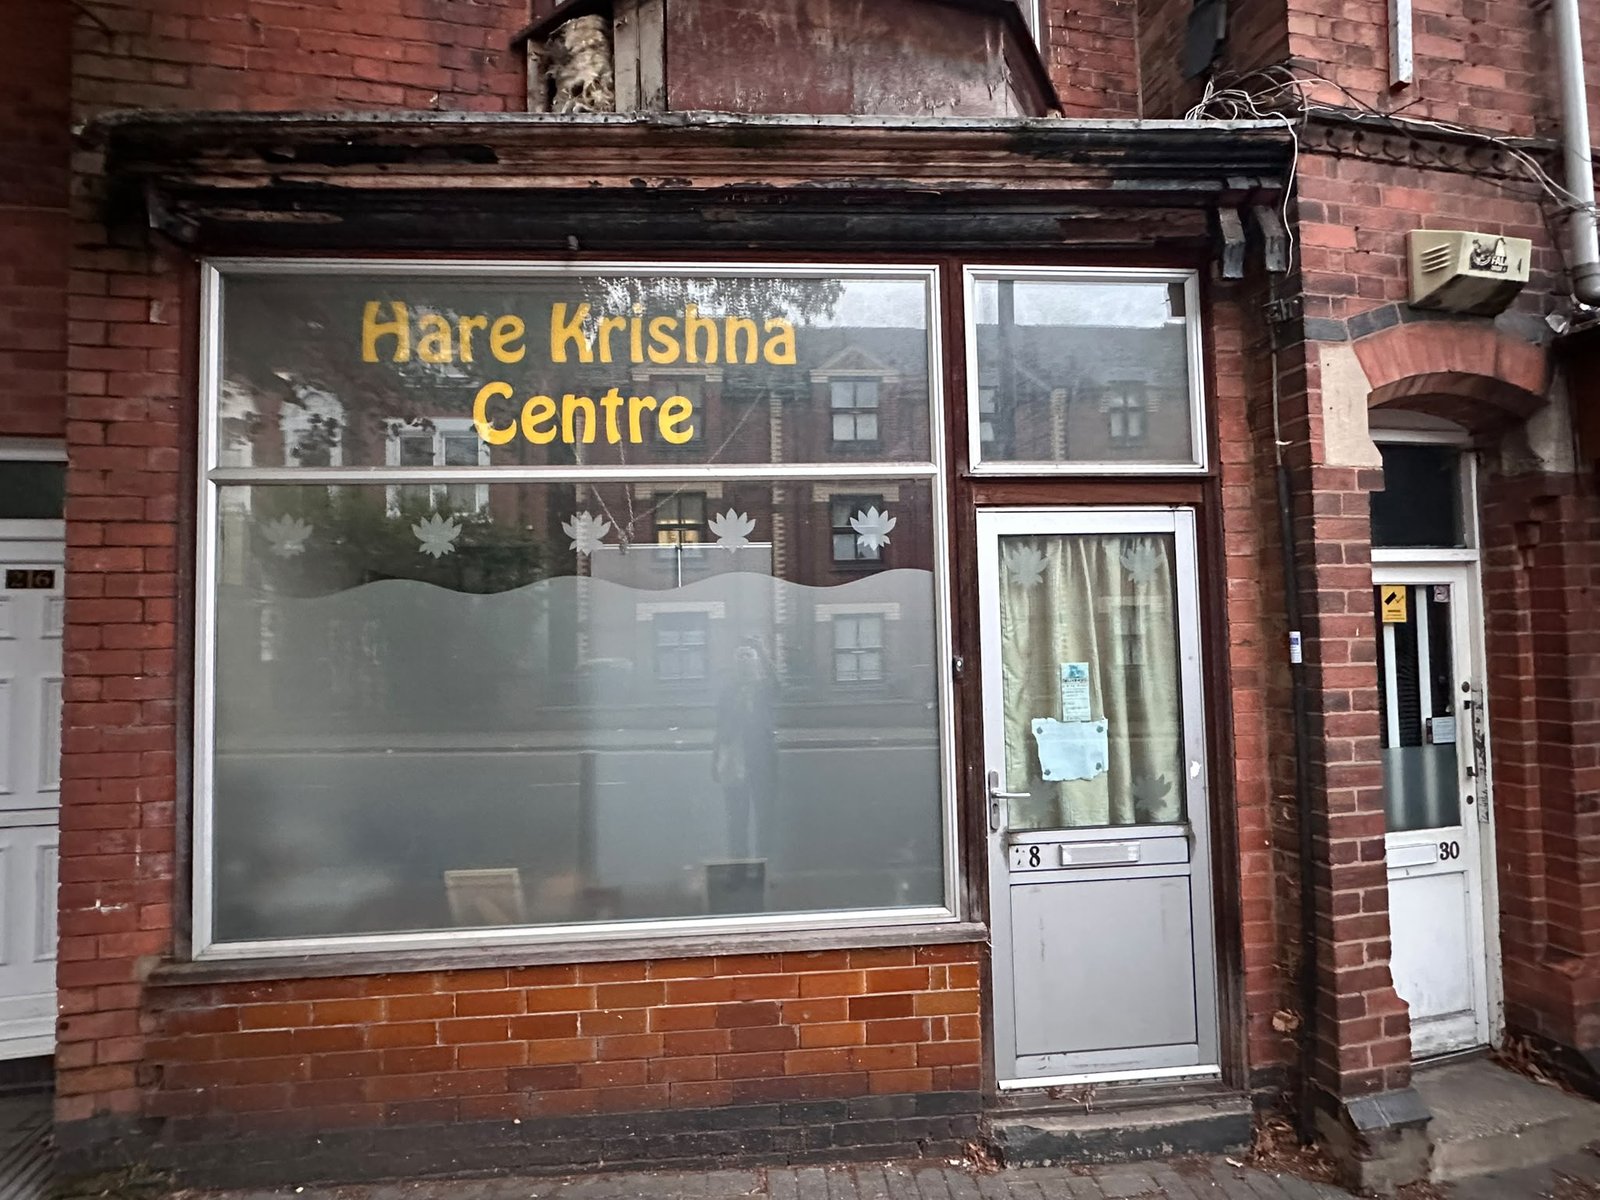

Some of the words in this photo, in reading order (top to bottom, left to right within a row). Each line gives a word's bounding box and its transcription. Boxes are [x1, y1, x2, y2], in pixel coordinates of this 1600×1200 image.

[362, 300, 526, 365] Hare
[550, 302, 796, 366] Krishna
[472, 381, 695, 445] Centre
[1439, 840, 1460, 861] 30
